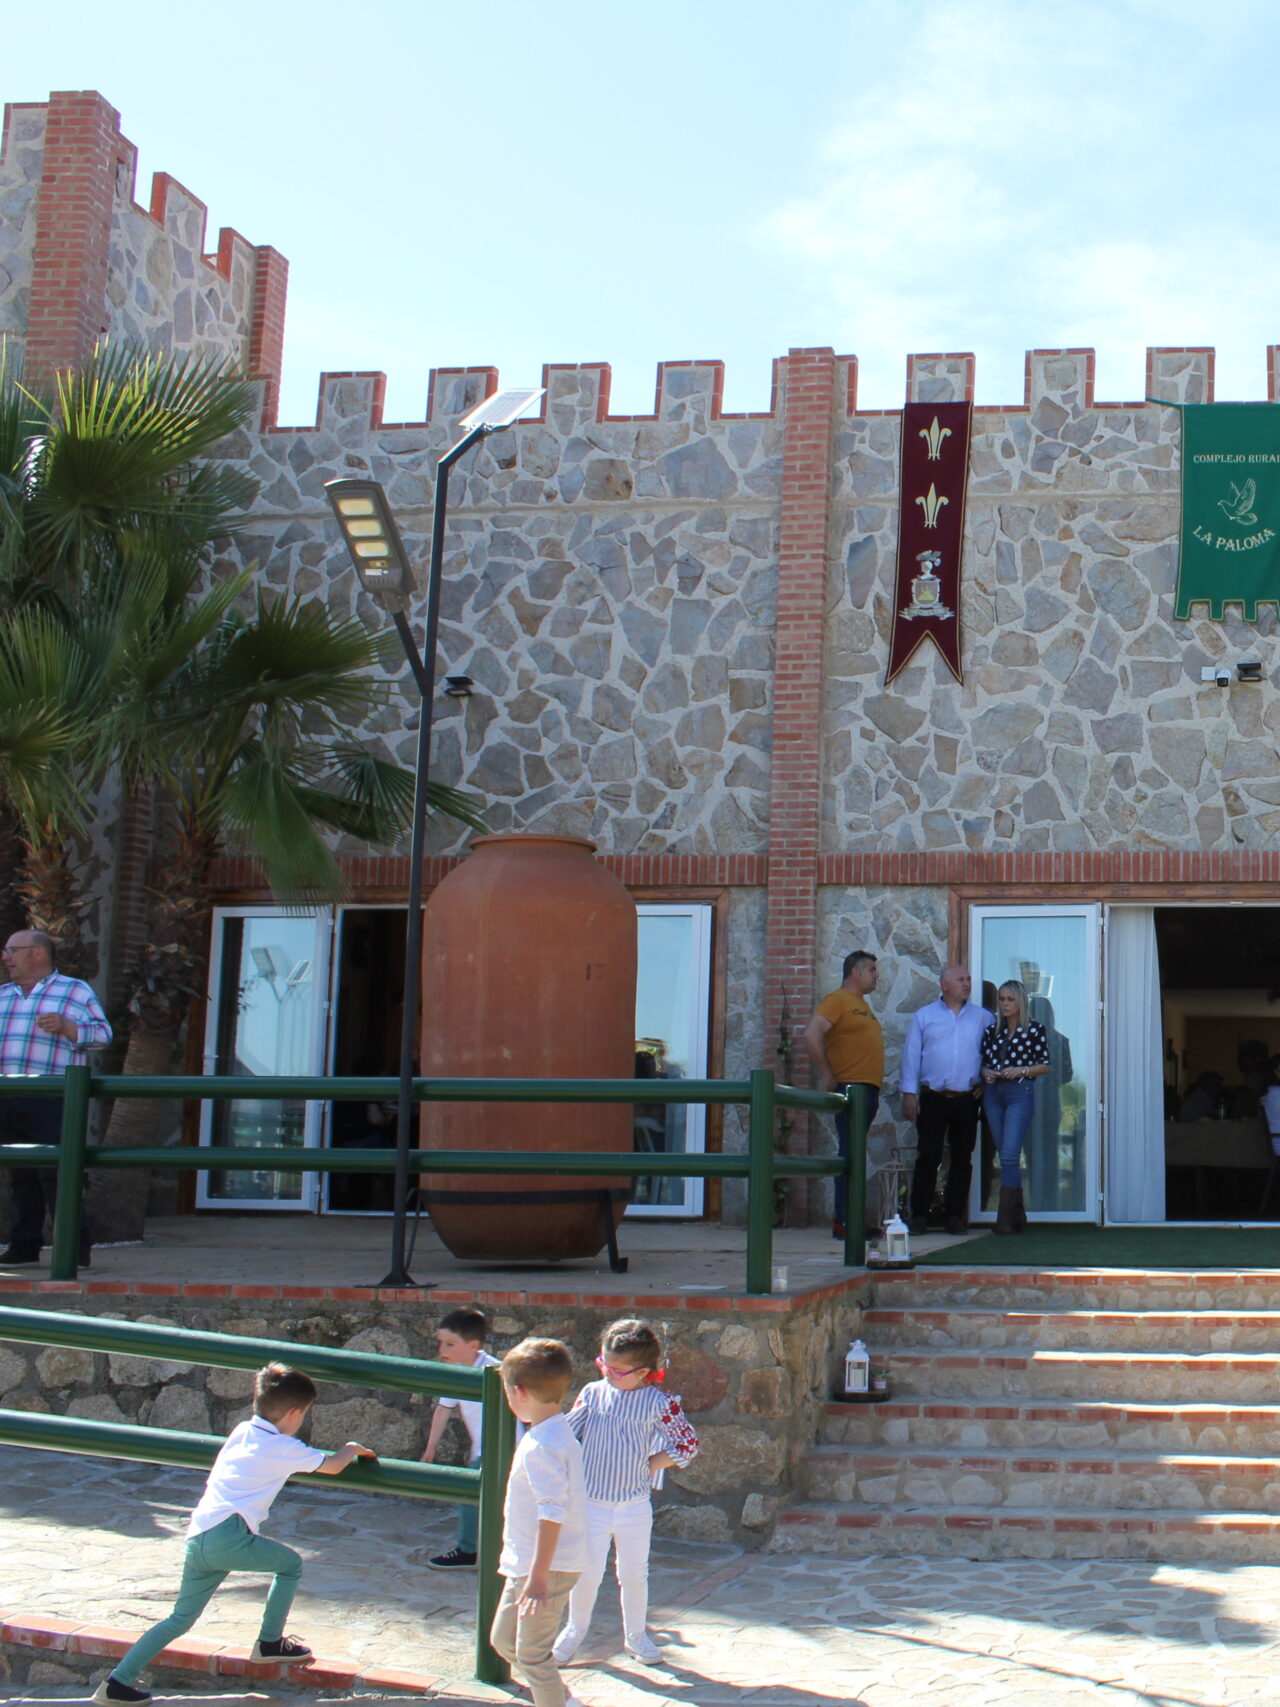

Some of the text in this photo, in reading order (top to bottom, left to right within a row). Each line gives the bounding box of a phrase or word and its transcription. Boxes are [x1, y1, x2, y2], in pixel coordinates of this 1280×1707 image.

[1193, 454, 1246, 464] COMPLEJO
[1192, 525, 1277, 551] LA PALOMA
